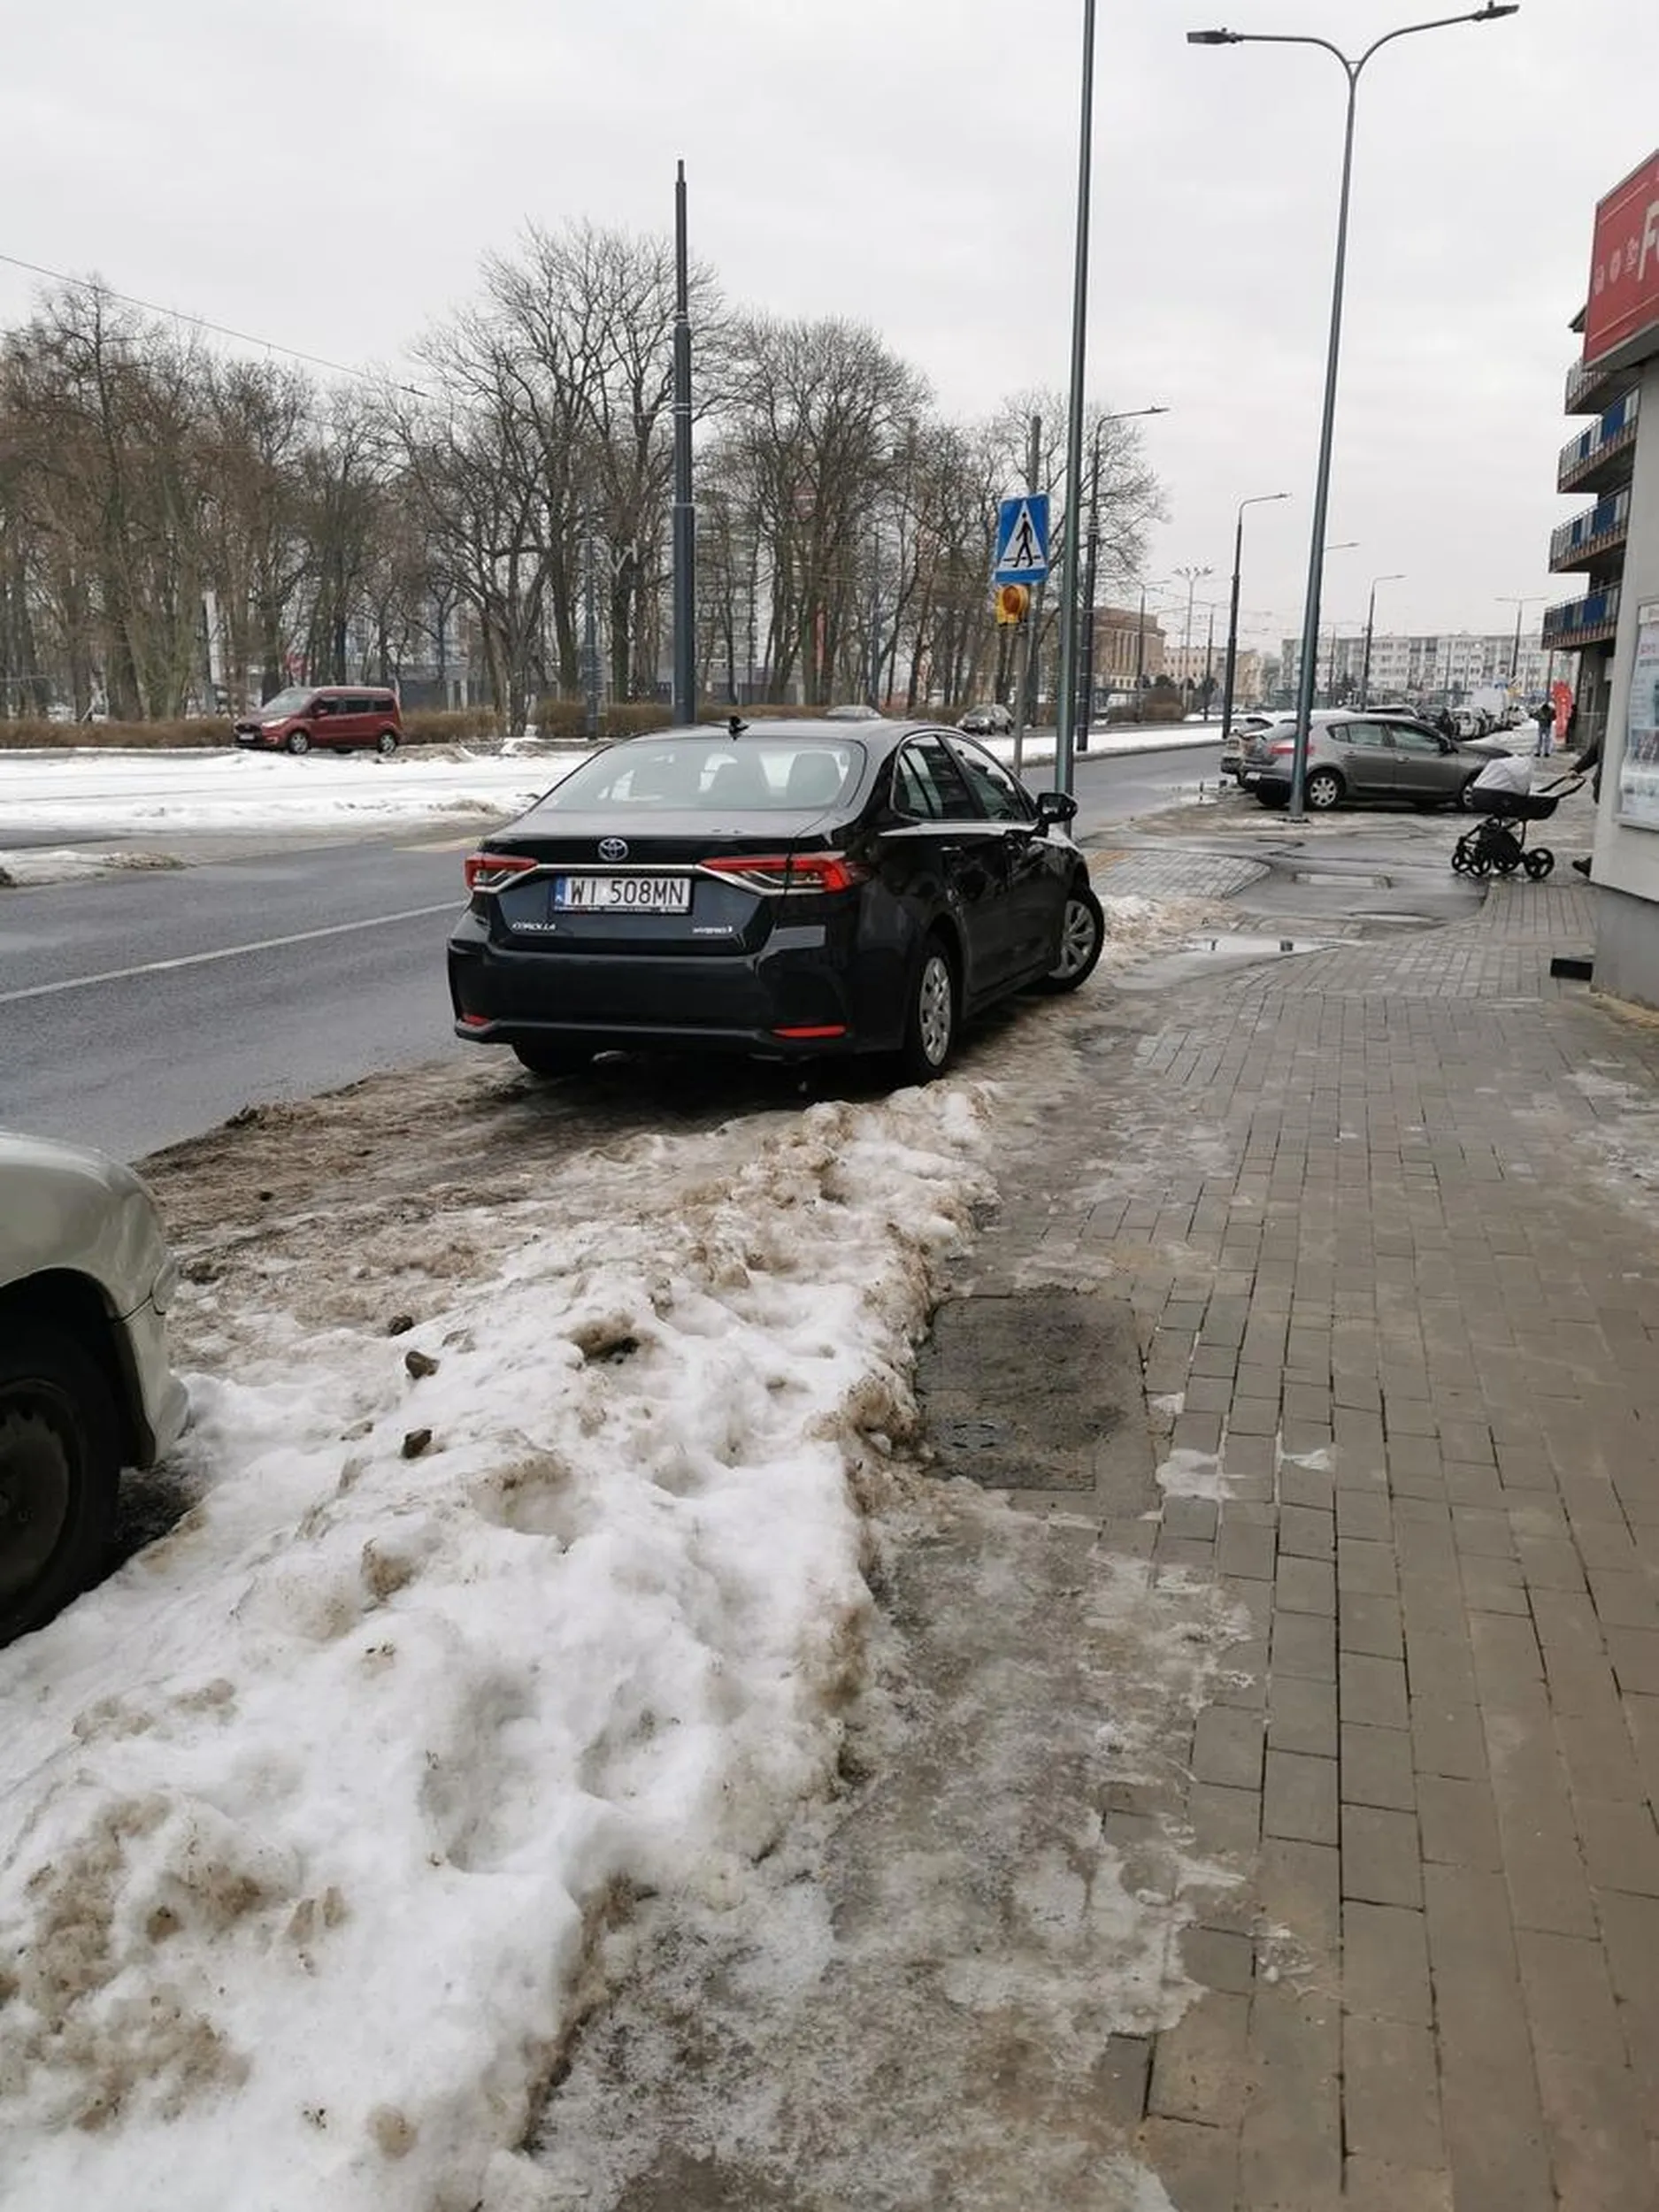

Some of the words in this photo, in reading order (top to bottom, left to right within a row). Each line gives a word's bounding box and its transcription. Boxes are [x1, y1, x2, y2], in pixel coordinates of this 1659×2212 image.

[1638, 200, 1659, 281] F
[571, 880, 596, 903] WI
[611, 879, 683, 904] 508MN
